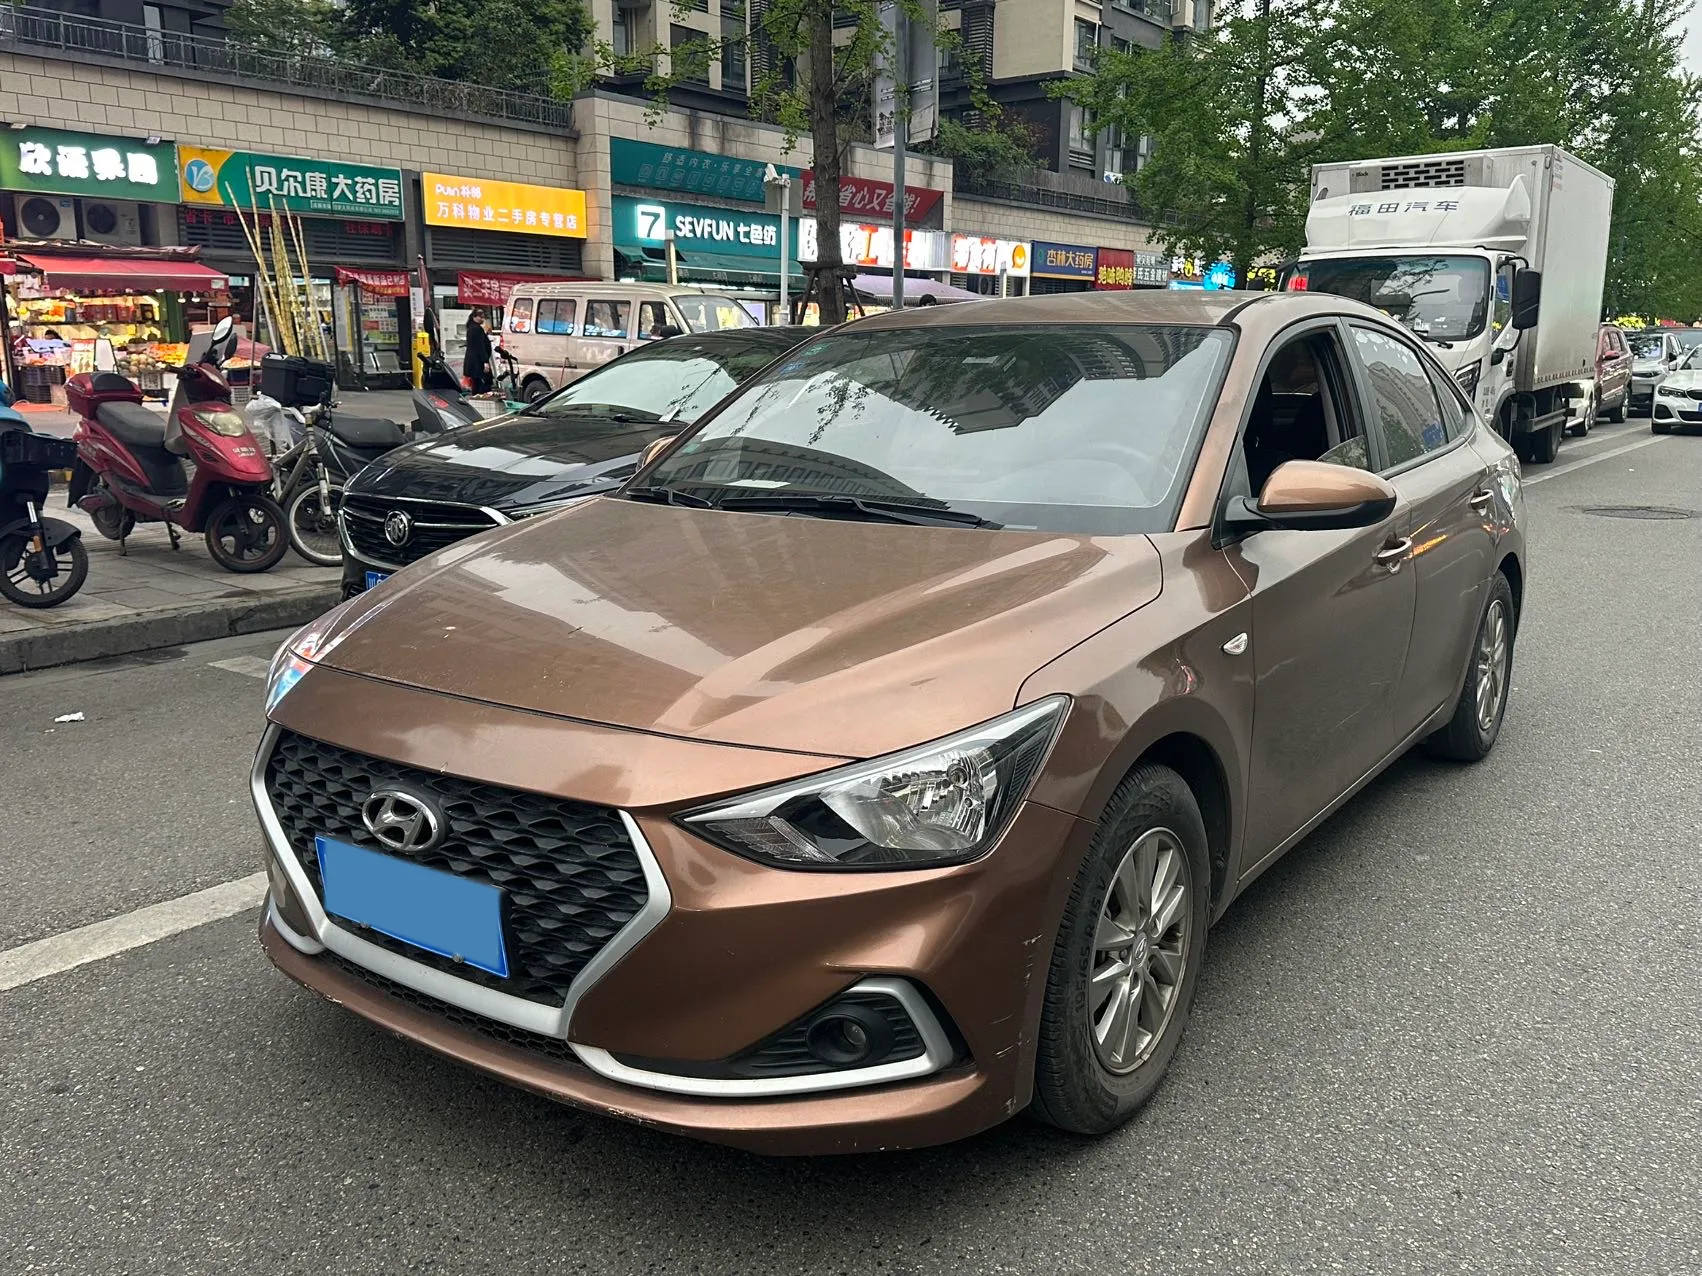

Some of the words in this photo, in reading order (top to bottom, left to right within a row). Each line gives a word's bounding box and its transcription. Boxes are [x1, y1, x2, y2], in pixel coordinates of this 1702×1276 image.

[255, 166, 400, 206] 贝尔康大药房
[803, 180, 920, 215] 帮省心又省钱!
[437, 202, 577, 229] 万科物业二手房专营店
[1348, 200, 1459, 216] 福田汽车
[641, 211, 661, 237] 7
[675, 215, 734, 241] SEVFUN
[737, 222, 776, 246] 七色纺
[1047, 249, 1094, 269] 杏林大药房
